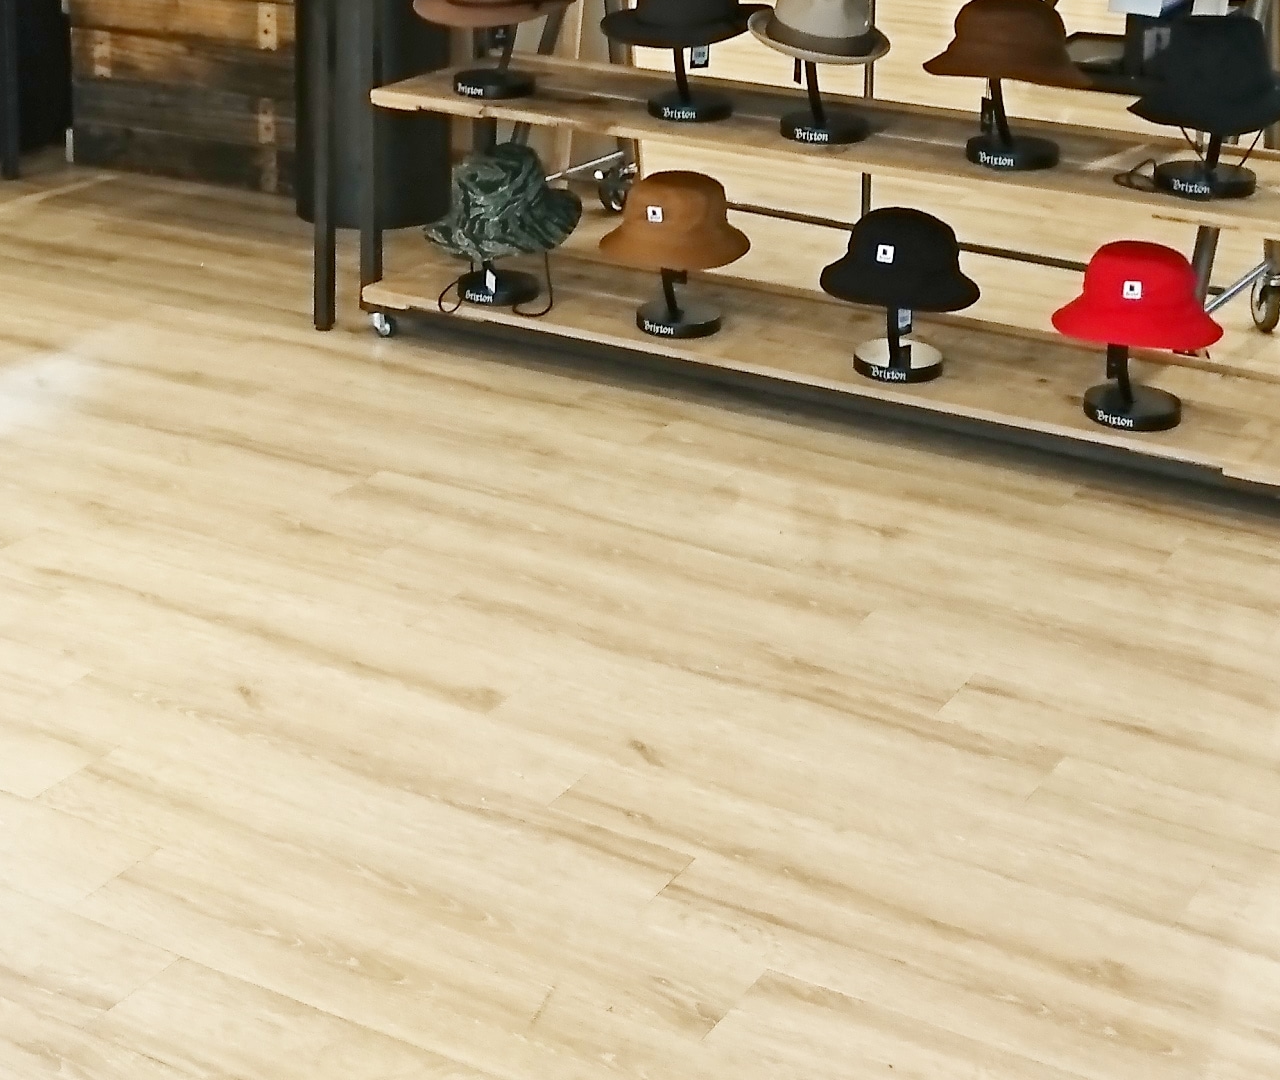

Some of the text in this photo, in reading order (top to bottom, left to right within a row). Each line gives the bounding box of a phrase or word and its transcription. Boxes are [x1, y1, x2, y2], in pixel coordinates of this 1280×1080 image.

[663, 107, 696, 120] Brixton
[793, 127, 829, 142] Brixton
[977, 151, 1015, 167] Brixton
[1170, 178, 1211, 195] Brixton
[465, 289, 493, 304] Brixton
[642, 320, 674, 336] Brixton
[870, 364, 907, 381] Brixton
[1095, 408, 1135, 429] Brixton
